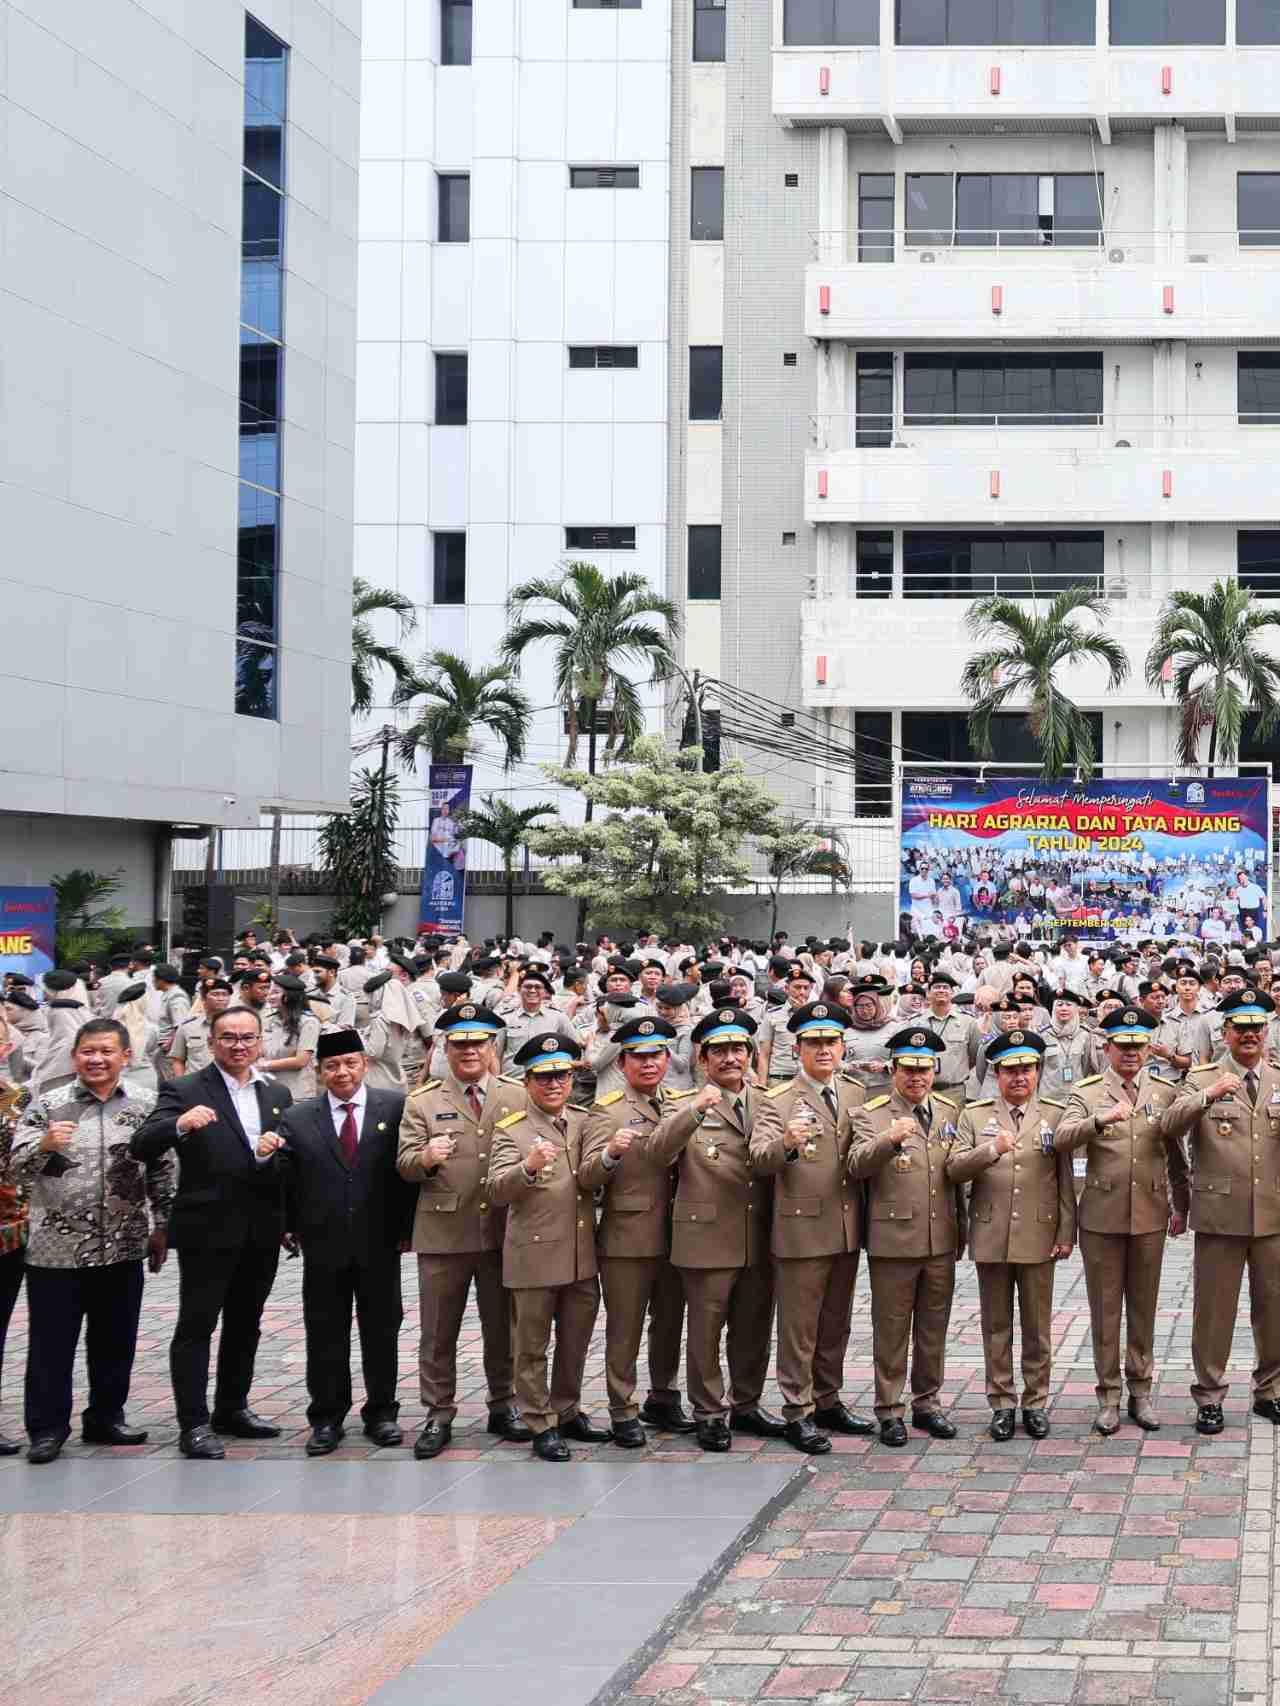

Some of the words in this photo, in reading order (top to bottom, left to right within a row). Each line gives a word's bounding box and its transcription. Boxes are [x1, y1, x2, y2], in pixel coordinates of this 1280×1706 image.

[1015, 788, 1070, 809] Selamat
[1072, 790, 1153, 813] Memperingati
[928, 813, 978, 829] HARI
[983, 814, 1071, 830] AGRARIA
[1076, 815, 1116, 831] DAN
[1122, 816, 1167, 832] TATA
[1173, 816, 1241, 832] RUANG
[1027, 835, 1091, 850] TAHUN
[1096, 836, 1144, 851] 2024
[1049, 919, 1107, 928] SEPTEMBER
